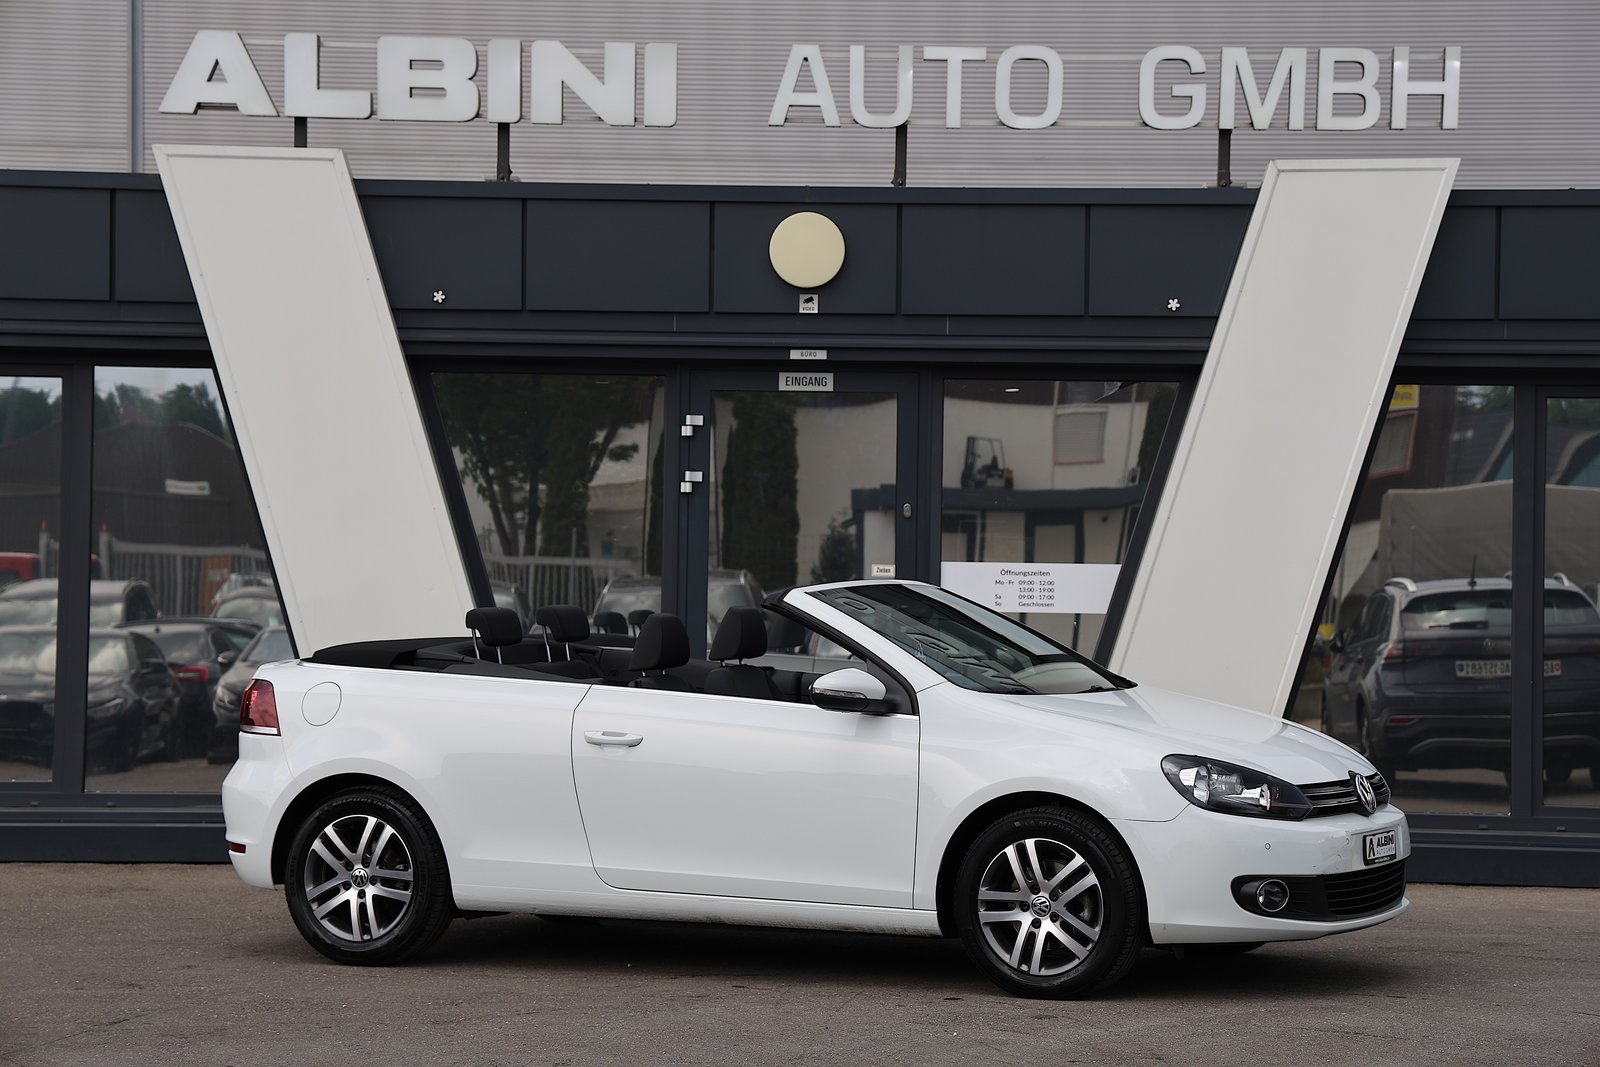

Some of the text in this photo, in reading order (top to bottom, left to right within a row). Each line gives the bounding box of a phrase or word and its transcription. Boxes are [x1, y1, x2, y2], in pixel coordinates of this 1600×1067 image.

[158, 30, 1462, 131] ALBINI AUTO GMBH
[786, 376, 828, 387] EINGANG
[1000, 569, 1050, 577] Öffnungszeiten
